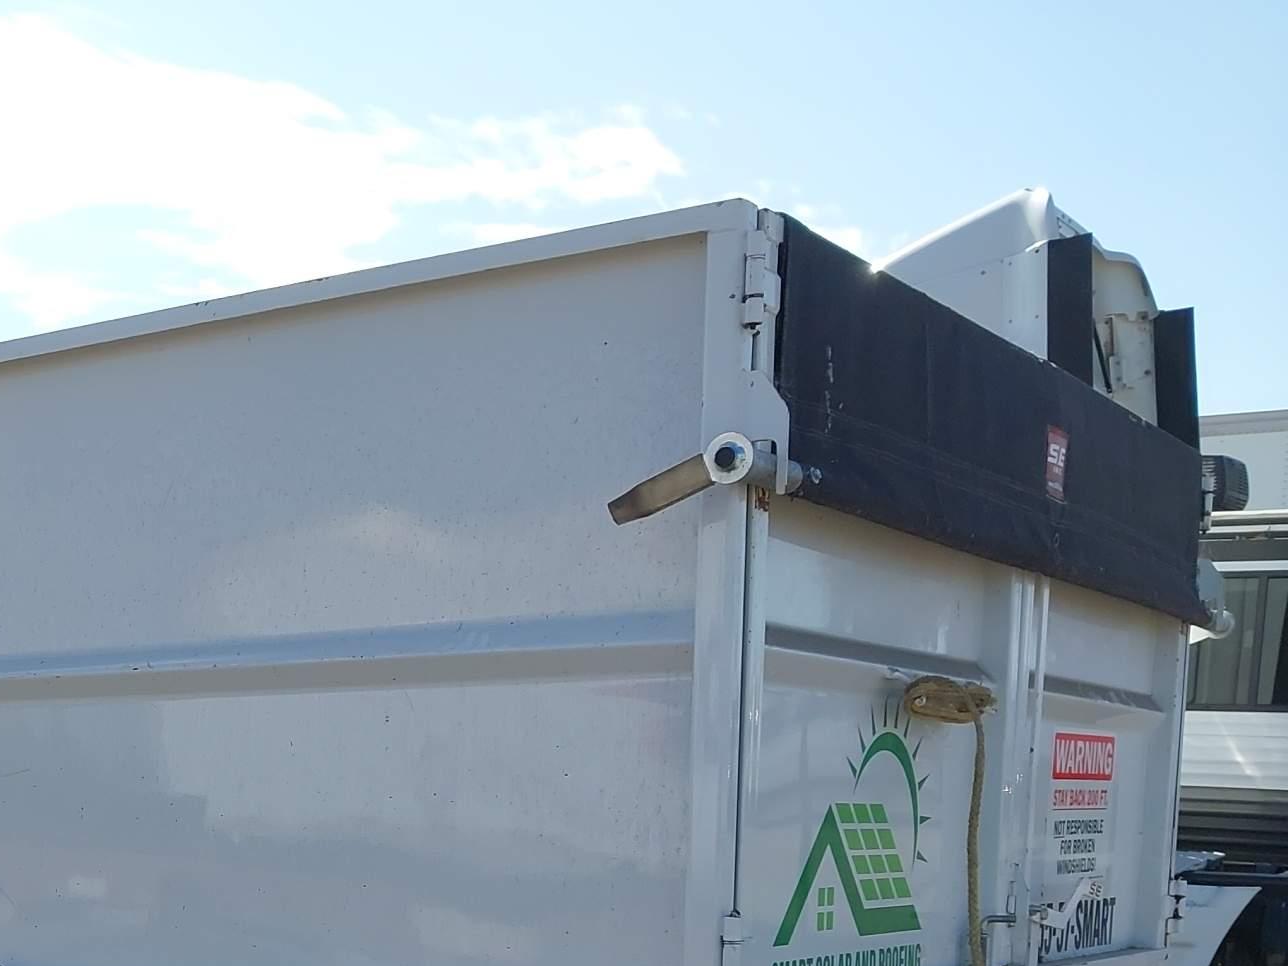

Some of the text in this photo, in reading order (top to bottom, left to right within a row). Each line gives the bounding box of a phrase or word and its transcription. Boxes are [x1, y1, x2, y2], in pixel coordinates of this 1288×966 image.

[1056, 739, 1113, 775] WARNING
[1054, 819, 1104, 835] NOT RESPONSIBLE
[1073, 839, 1095, 854] BROKEN
